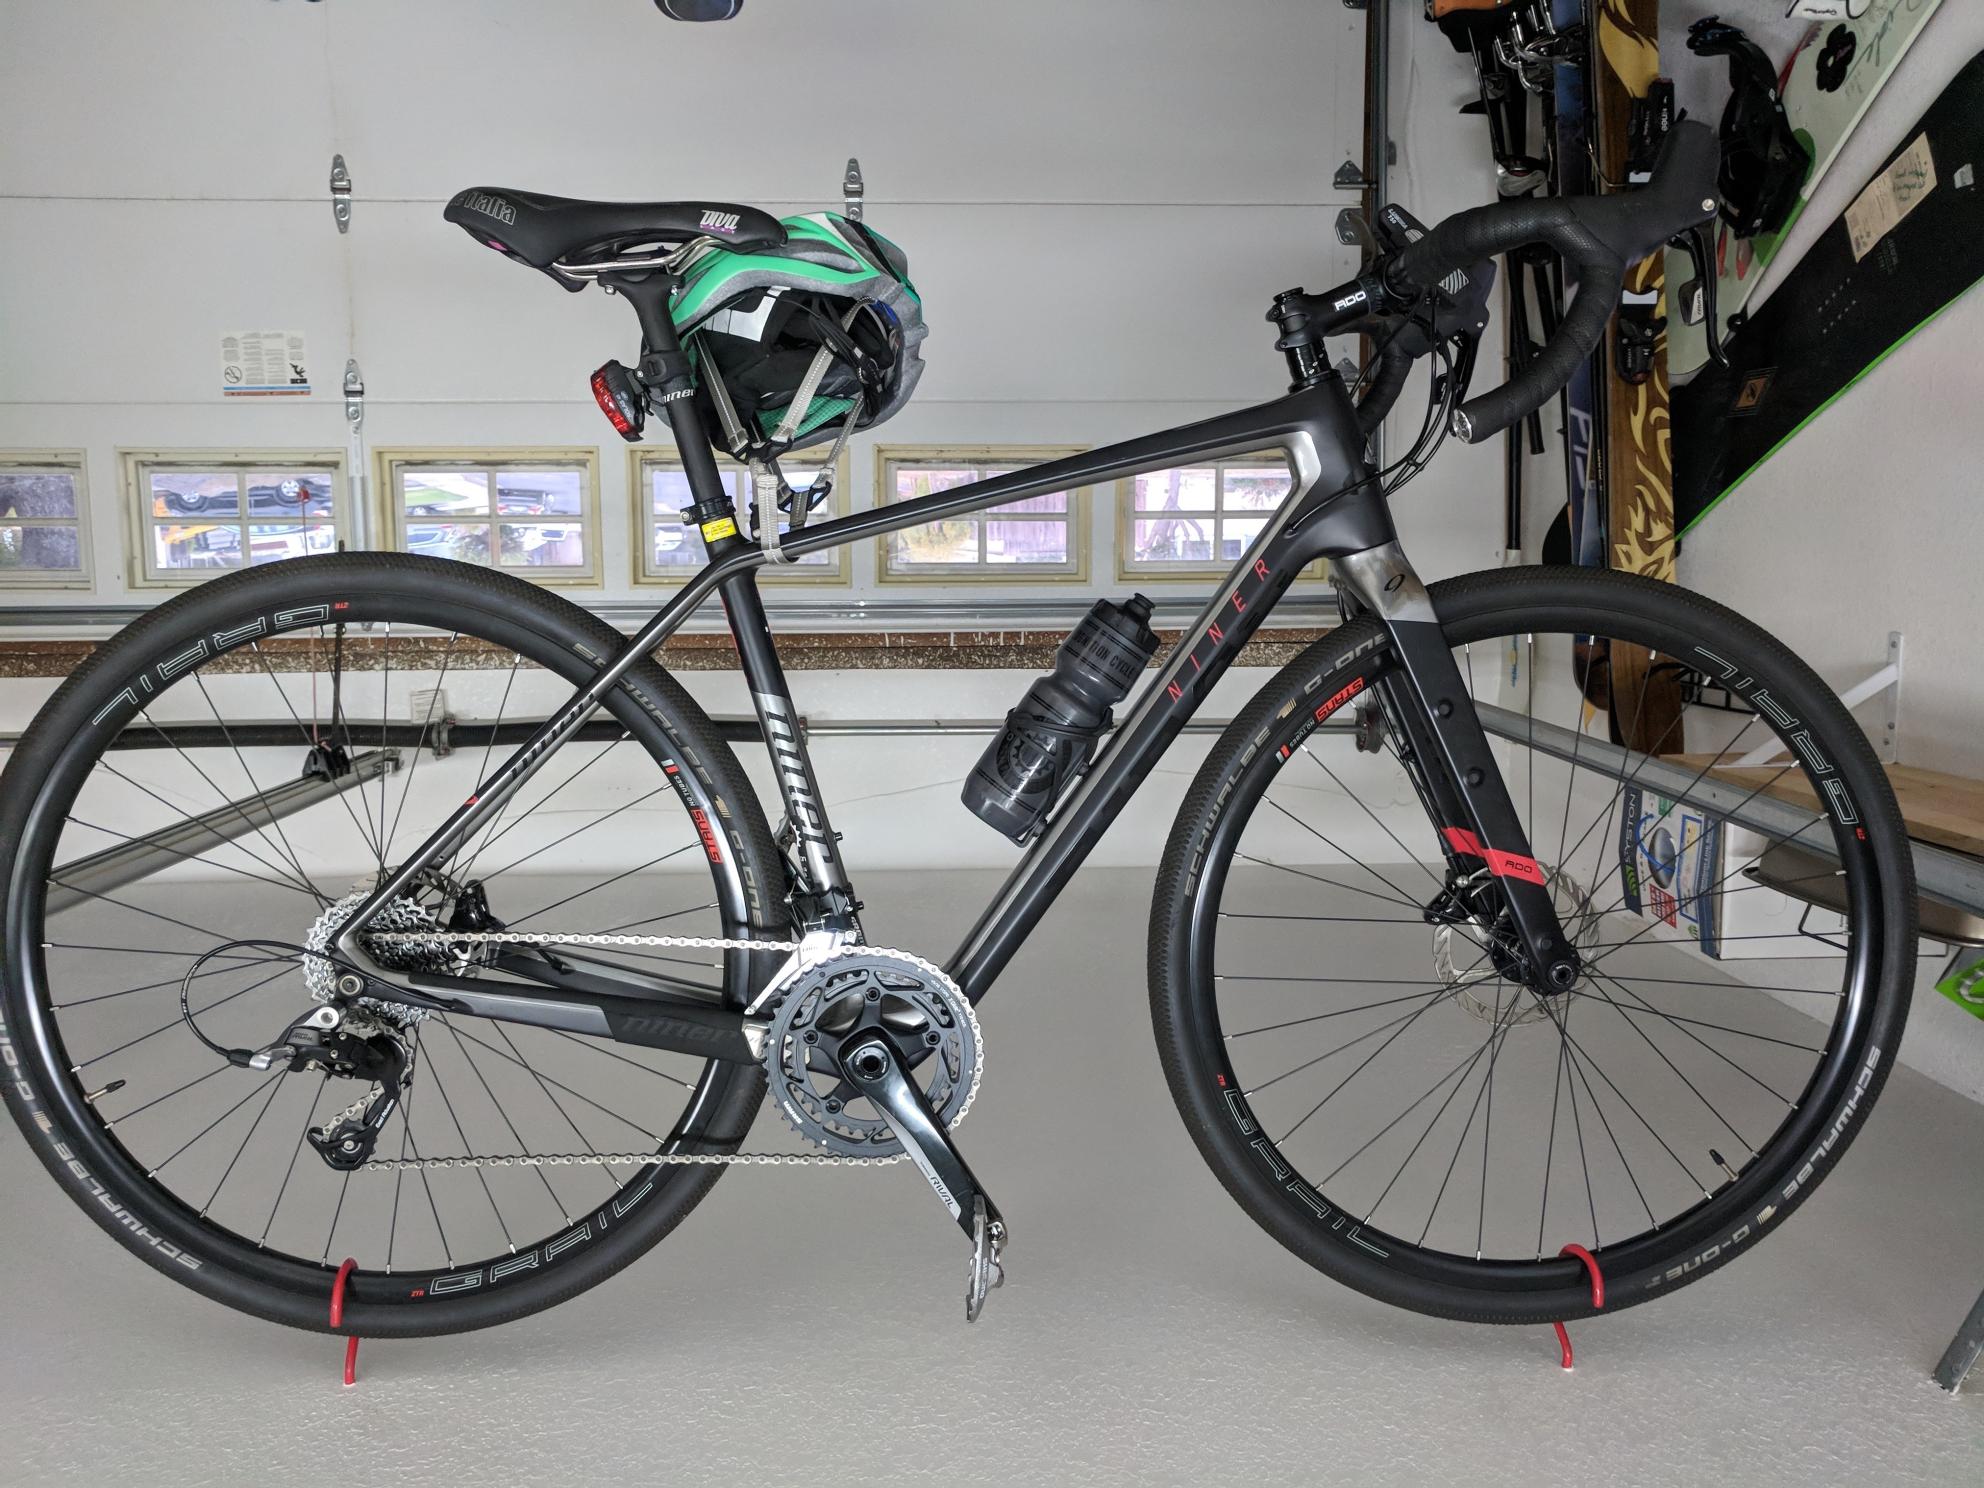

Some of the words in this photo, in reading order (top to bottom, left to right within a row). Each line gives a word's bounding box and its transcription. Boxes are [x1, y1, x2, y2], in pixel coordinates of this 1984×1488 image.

[1334, 291, 1367, 312] RDO
[92, 604, 329, 726] GRAIL
[1167, 557, 1272, 704] NINER
[765, 711, 835, 864] niner
[1694, 646, 1860, 825] GRAIL
[1183, 726, 1273, 898] SCHWALBE
[1504, 859, 1534, 875] RDO
[1223, 1088, 1390, 1258] GRAIL
[1782, 1045, 1882, 1201] SCHWALBE
[53, 1141, 203, 1271] SCHWALBE
[430, 1182, 653, 1296] GRAIL
[930, 1176, 955, 1210] RIVAL
[1665, 1224, 1751, 1282] G-ONE
